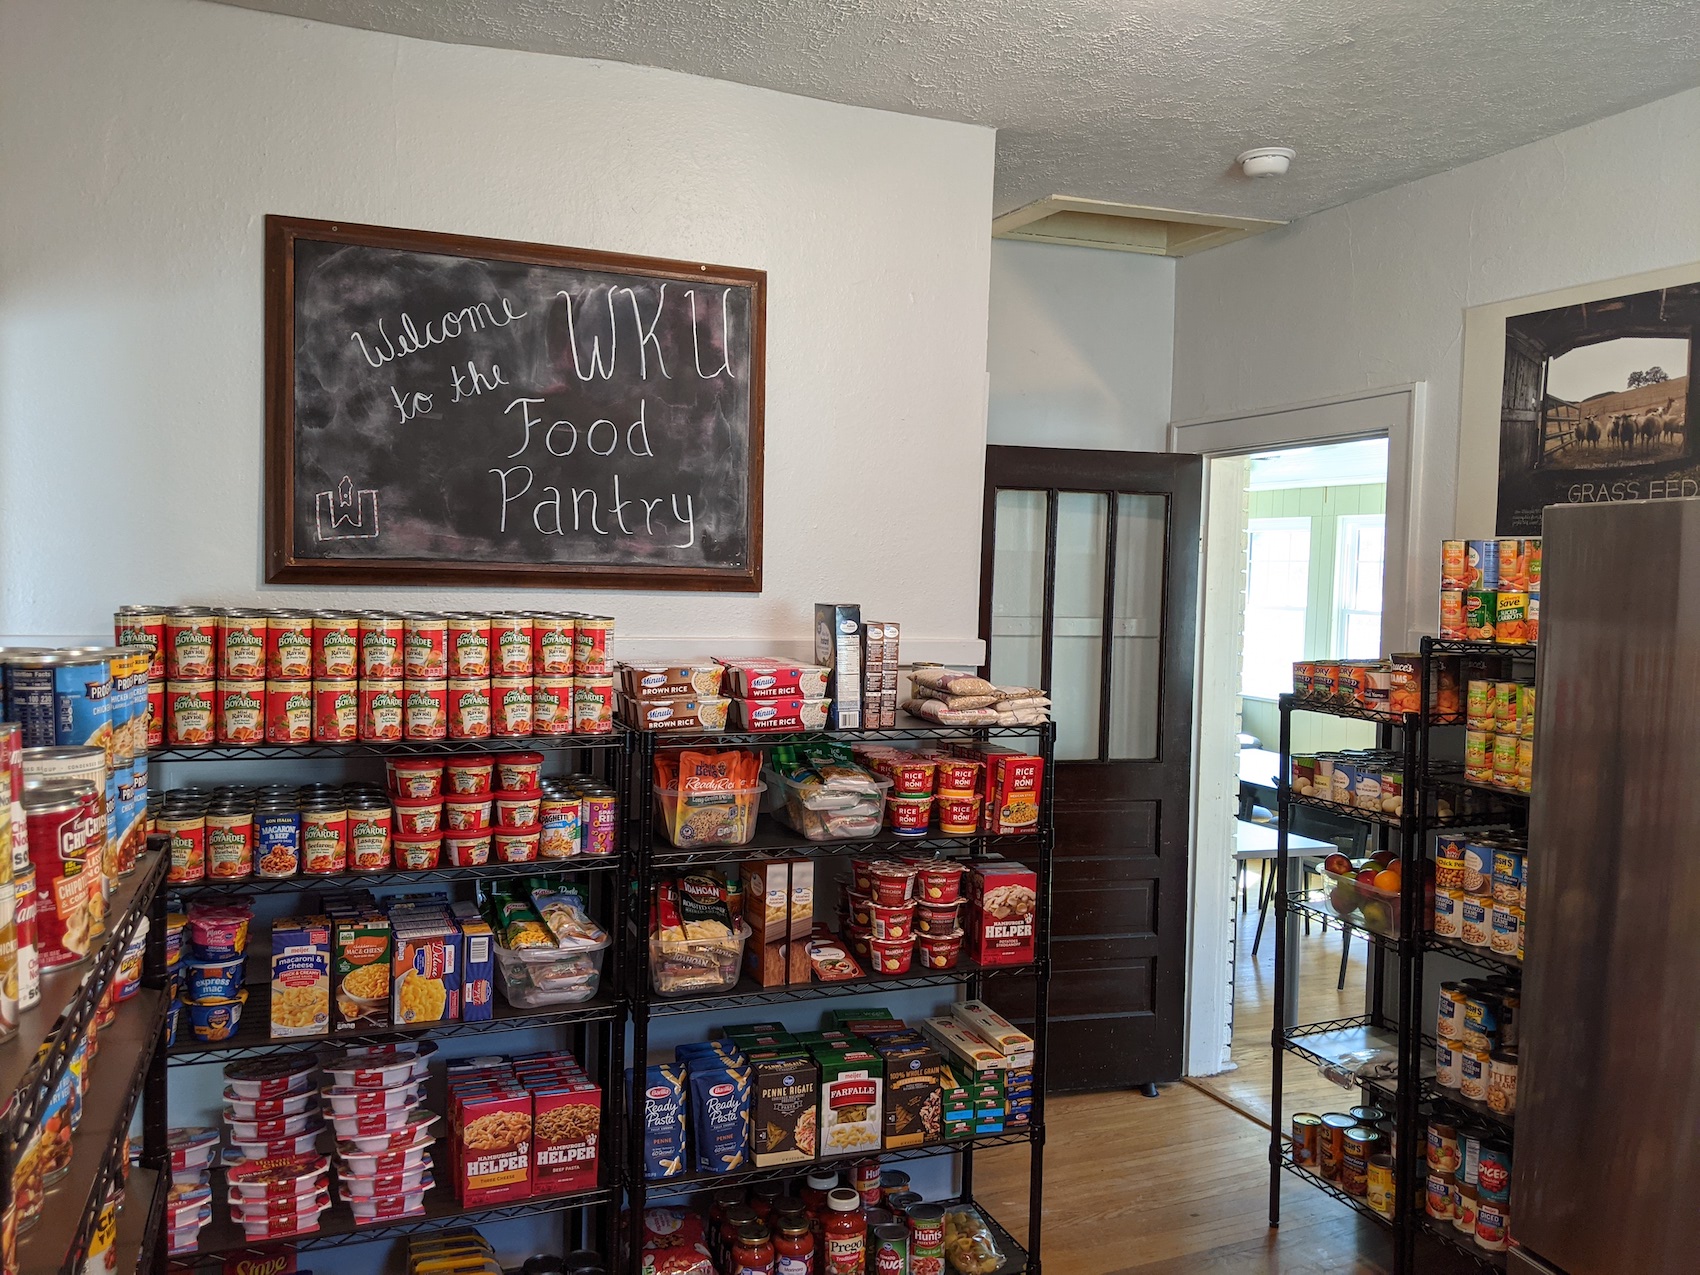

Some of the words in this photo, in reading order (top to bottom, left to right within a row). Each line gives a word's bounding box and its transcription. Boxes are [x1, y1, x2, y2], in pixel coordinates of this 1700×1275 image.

[351, 297, 528, 367] Welcome
[557, 283, 735, 382] WKU
[393, 385, 433, 424] to
[450, 360, 509, 404] the
[504, 398, 654, 459] Food
[1567, 482, 1641, 504] GRASS
[489, 465, 695, 549] Pantry
[1499, 600, 1520, 608] Save
[120, 634, 157, 644] BOYARDEE
[175, 635, 212, 645] BOYARDEE
[227, 636, 263, 646] BOYARDEE
[279, 637, 311, 646] BOYARDEE
[324, 637, 356, 646] BOYARDEE
[363, 637, 397, 646] BOYARDEE
[457, 638, 488, 647] BOYARDEE
[500, 636, 531, 644] BOYARDEE
[542, 637, 572, 646] BOYARDEE
[642, 675, 668, 686] Minute
[752, 676, 776, 688] Minute
[642, 687, 669, 695] BROWN
[671, 686, 688, 694] RICE
[753, 688, 779, 696] WHITE
[174, 701, 211, 710] BOYARDEE
[225, 700, 260, 710] BOYARDEE
[407, 698, 440, 707] BOYARDEE
[648, 708, 674, 718] Minute
[753, 708, 777, 718] Minute
[648, 720, 675, 729] BROWN
[677, 719, 694, 727] RICE
[754, 719, 780, 728] WHITE
[782, 718, 797, 726] RICE
[1014, 779, 1033, 787] RONI
[305, 830, 339, 840] BOYARDEE
[353, 828, 388, 837] BOYARDEE
[209, 834, 245, 844] BOYARDEE
[683, 882, 720, 898] IDAHOAN
[985, 924, 1032, 938] HELPER
[279, 956, 315, 965] macaroni
[431, 941, 444, 977] Deluxe
[196, 978, 230, 987] express
[202, 985, 222, 993] mac
[889, 1070, 906, 1080] 100%
[906, 1068, 923, 1078] WHOLE
[923, 1066, 940, 1075] GRAIN
[762, 1087, 787, 1098] PENNE
[789, 1083, 814, 1094] RIGATE
[831, 1086, 875, 1098] FARFALLE
[645, 1099, 678, 1115] Ready
[706, 1095, 741, 1113] Ready
[645, 1112, 676, 1128] Pasta
[709, 1110, 738, 1125] Pasta
[547, 1142, 586, 1152] HAMBURGER
[477, 1151, 517, 1161] HAMBURGER
[537, 1146, 596, 1165] HELPER
[467, 1155, 528, 1176] HELPER
[1480, 1212, 1500, 1222] DICED
[830, 1240, 863, 1253] Prego
[236, 1257, 288, 1275] Stove
